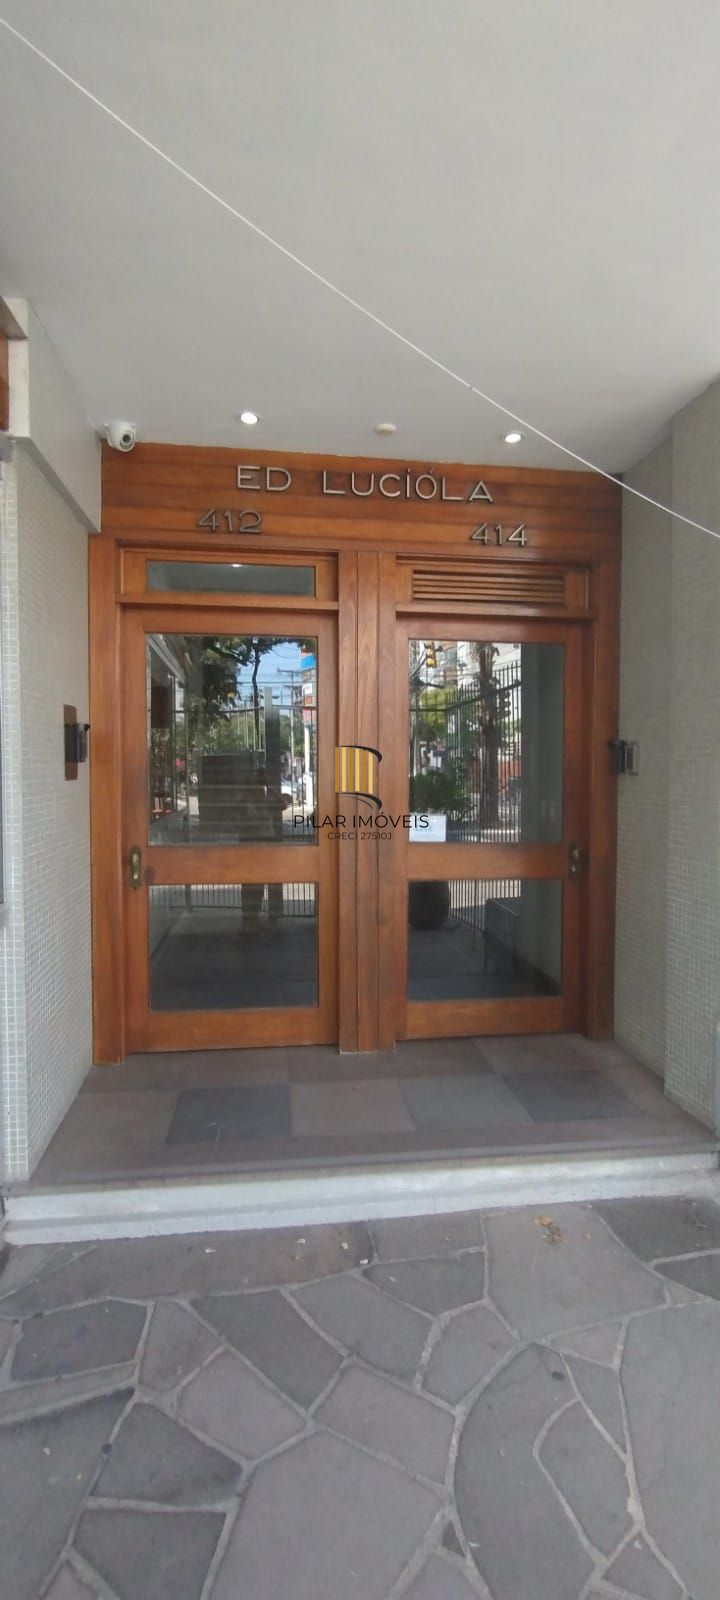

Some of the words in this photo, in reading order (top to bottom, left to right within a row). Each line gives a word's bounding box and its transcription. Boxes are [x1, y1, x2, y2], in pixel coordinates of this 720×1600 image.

[237, 465, 292, 492] ED
[198, 509, 263, 534] 412
[471, 522, 528, 546] 414
